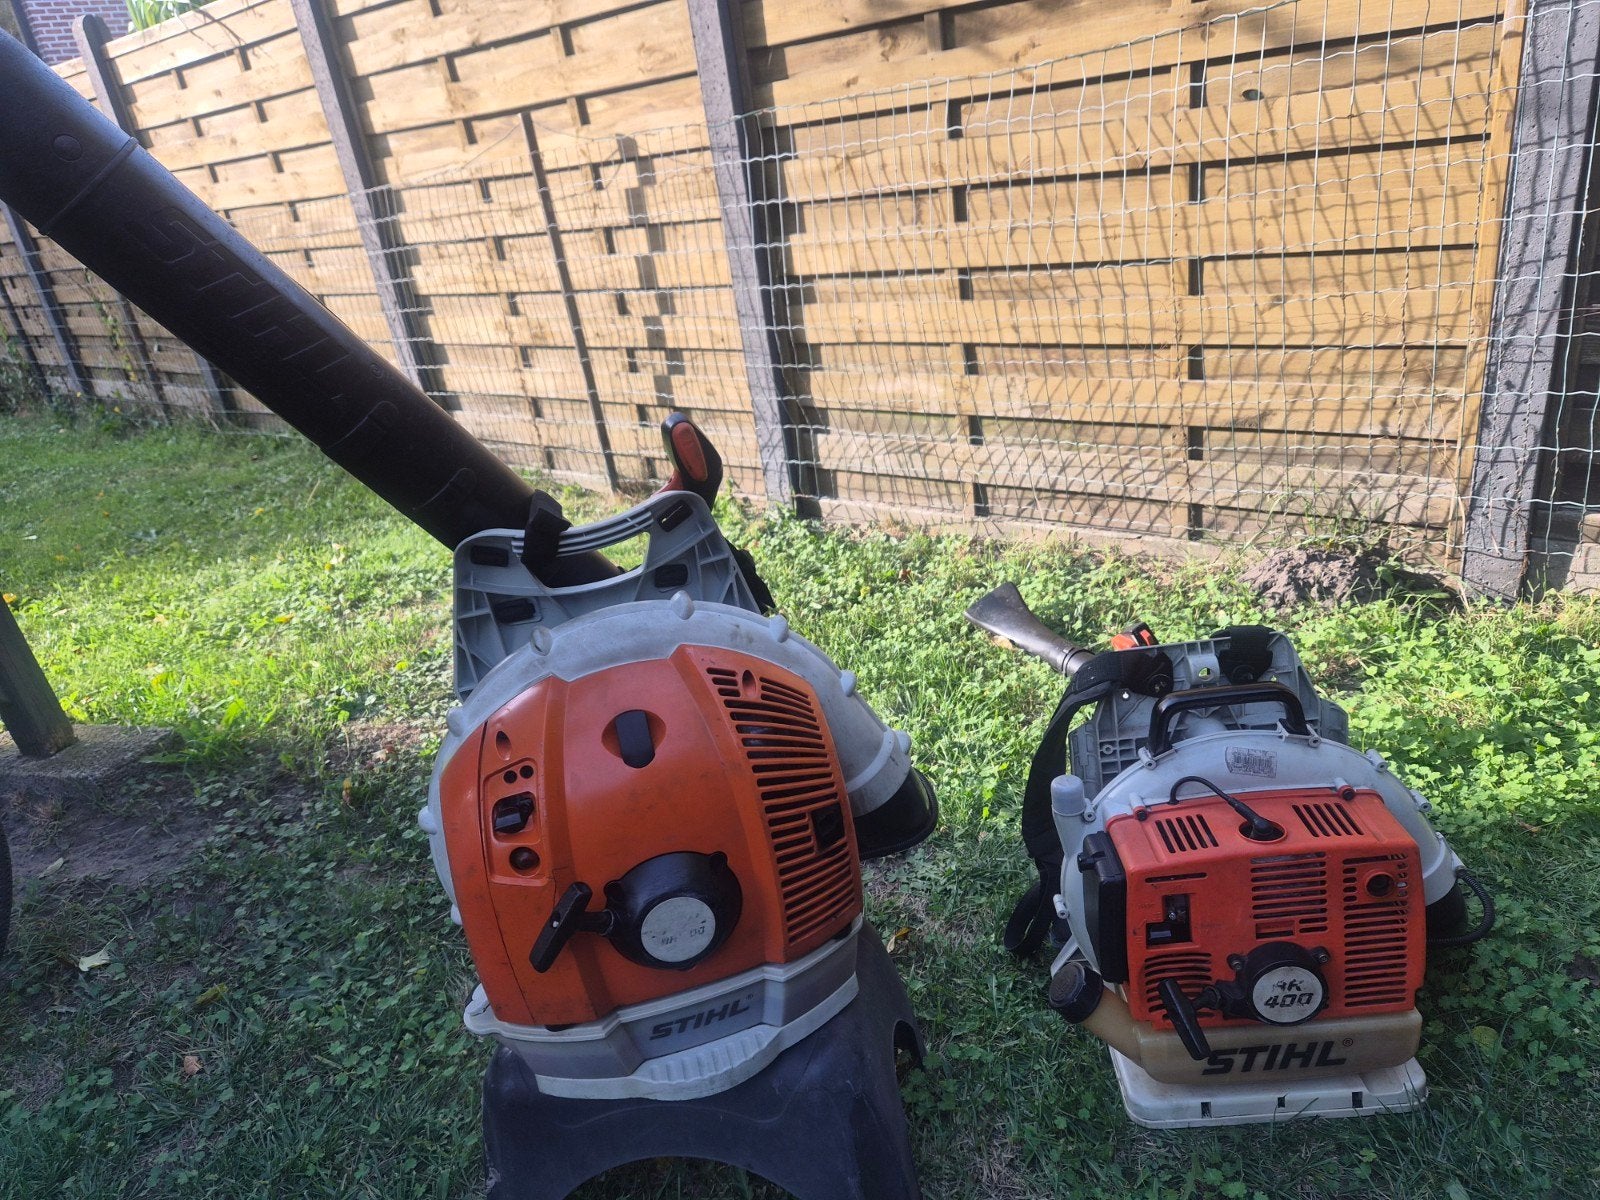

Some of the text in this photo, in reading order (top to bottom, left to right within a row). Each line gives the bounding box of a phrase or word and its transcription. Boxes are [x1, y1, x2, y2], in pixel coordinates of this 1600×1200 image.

[1264, 993, 1314, 1008] 400
[649, 1000, 750, 1040] STIHL
[1202, 1041, 1347, 1075] STIHL
